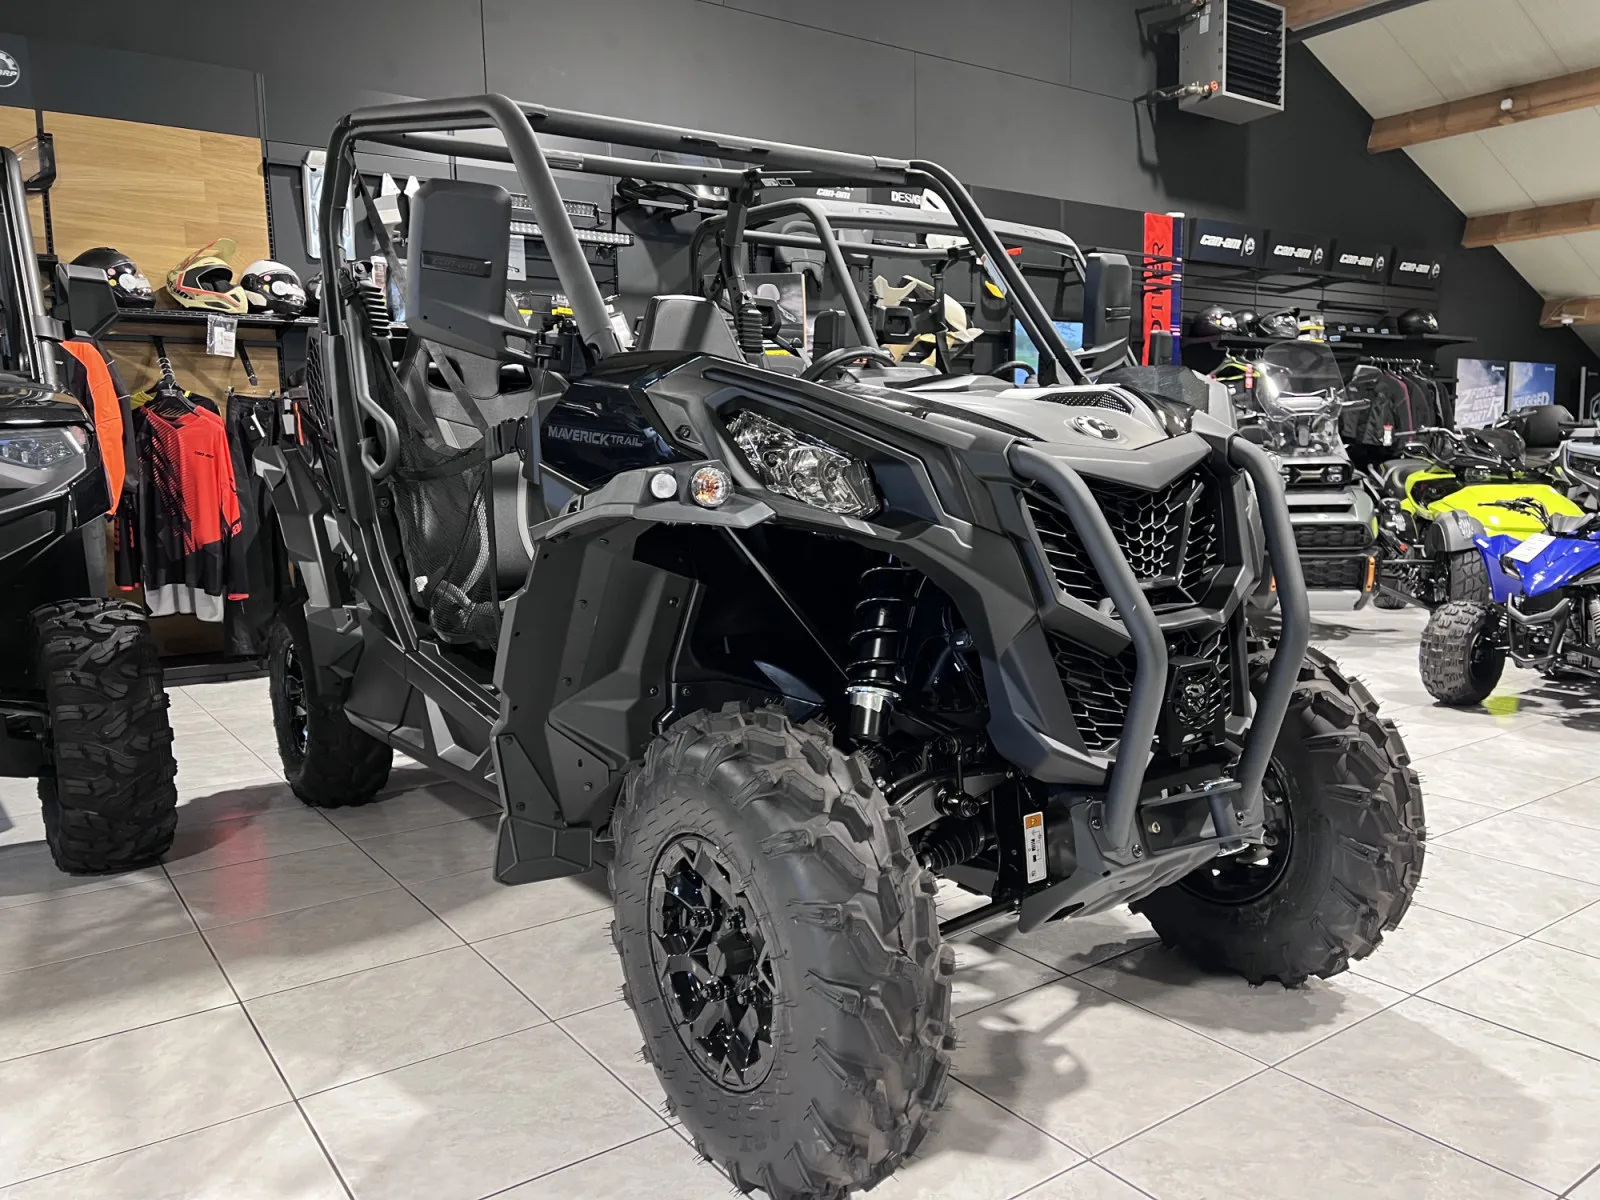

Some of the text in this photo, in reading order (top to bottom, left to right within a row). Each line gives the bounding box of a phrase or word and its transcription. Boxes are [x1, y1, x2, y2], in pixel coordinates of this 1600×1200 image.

[816, 188, 851, 200] can-am
[890, 190, 921, 205] DESIG
[1199, 234, 1242, 250] can-am
[1273, 245, 1312, 259] can-am
[1339, 253, 1374, 267] can-am
[1399, 261, 1431, 274] can-am
[548, 425, 643, 447] MAVERICK TRAIL
